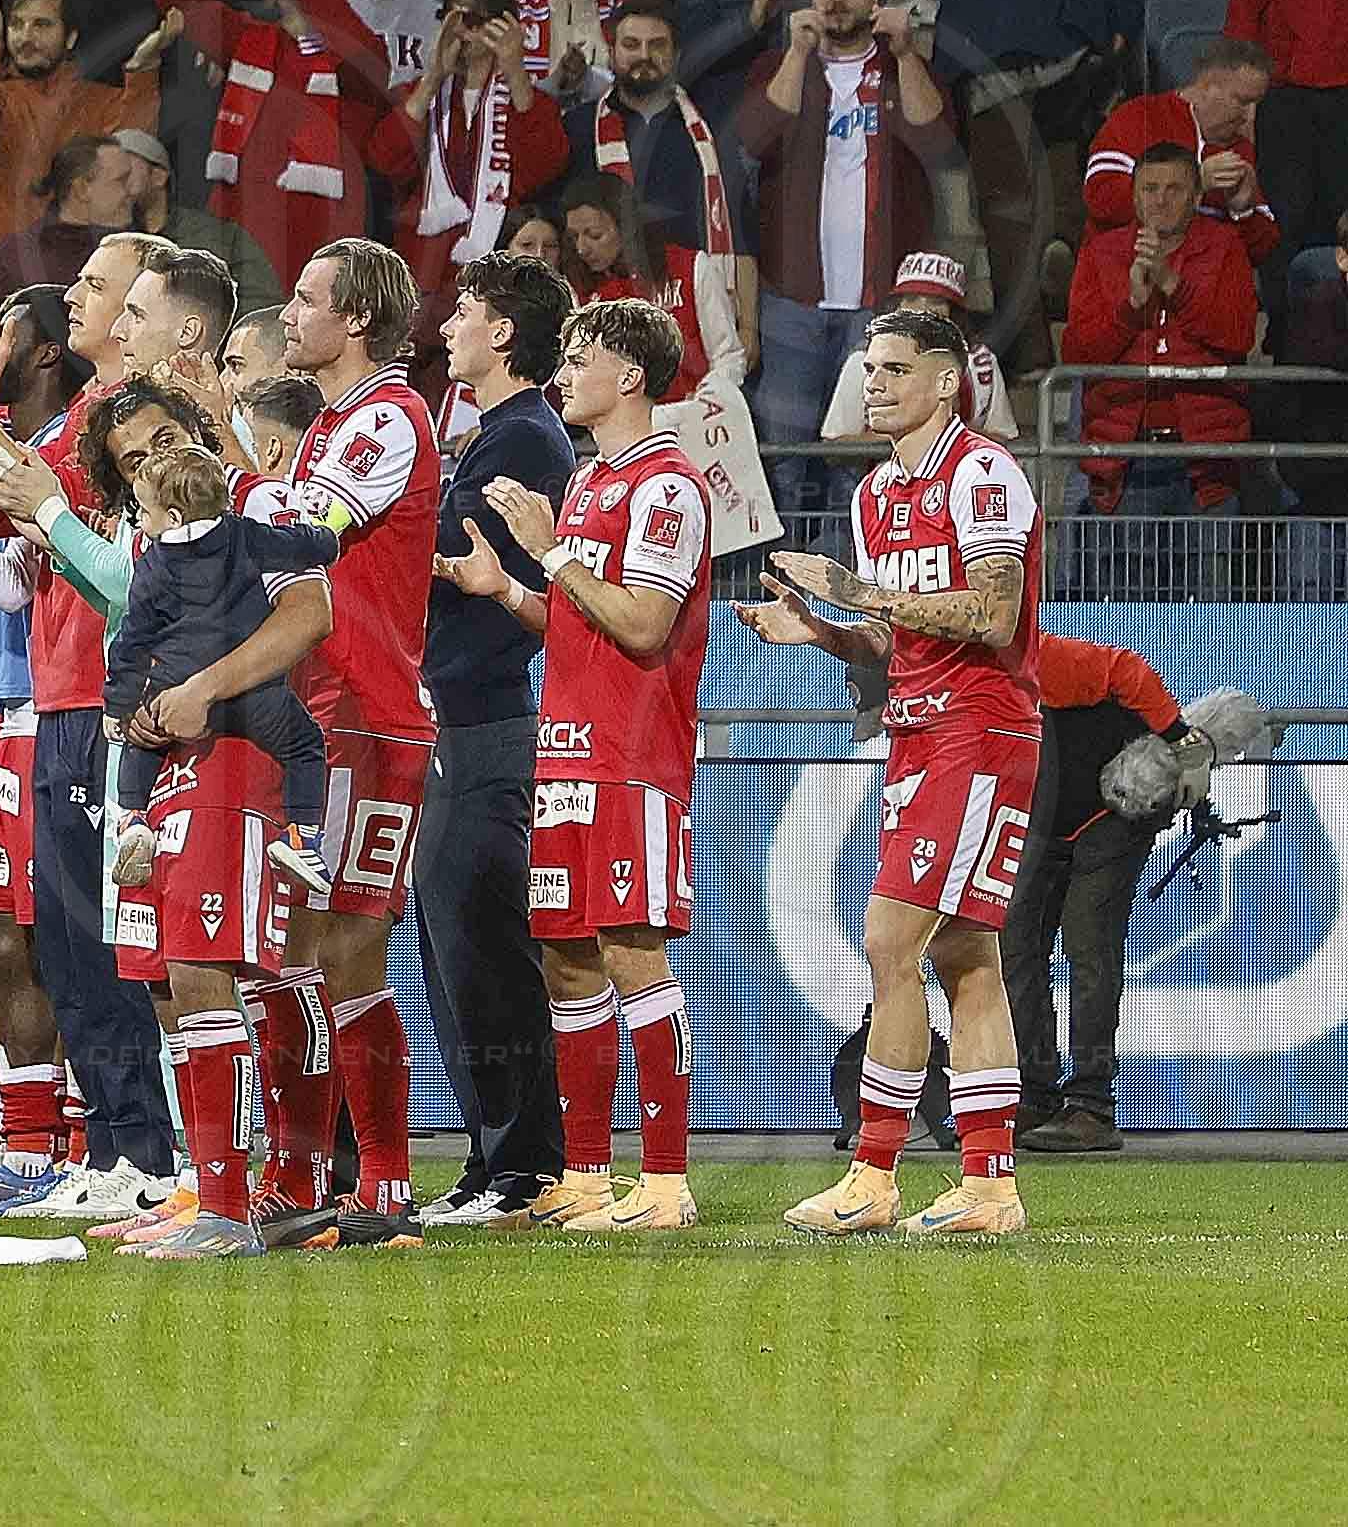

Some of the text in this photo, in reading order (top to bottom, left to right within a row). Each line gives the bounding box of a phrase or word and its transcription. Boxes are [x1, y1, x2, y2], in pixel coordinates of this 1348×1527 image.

[69, 785, 87, 804] 25
[913, 838, 937, 858] 28
[611, 859, 634, 878] 17
[201, 892, 224, 913] 22
[307, 993, 329, 1071] ENERGIE GRAZ
